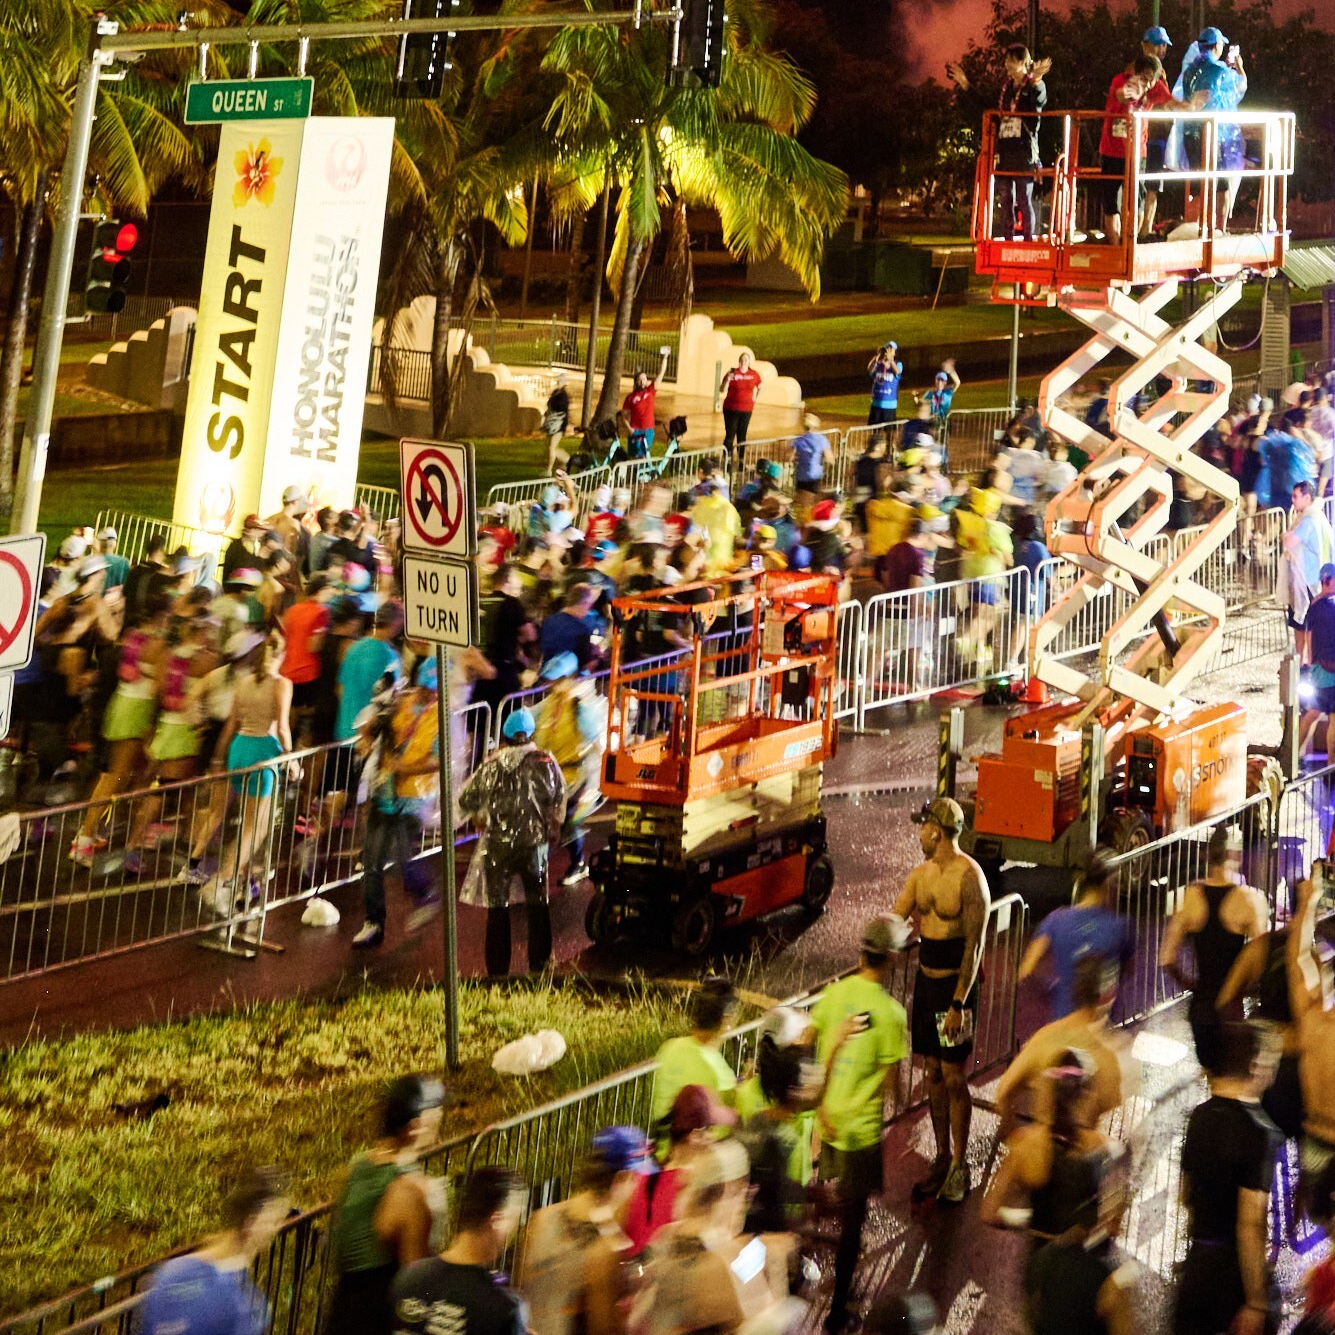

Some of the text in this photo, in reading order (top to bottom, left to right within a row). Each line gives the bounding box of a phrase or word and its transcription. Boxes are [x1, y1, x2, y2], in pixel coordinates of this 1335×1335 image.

[212, 89, 284, 113] QUEEN ST
[206, 223, 267, 460] START
[290, 233, 336, 459] HONOLULU
[316, 234, 361, 463] MARATHON
[416, 604, 459, 634] TURN
[417, 570, 457, 598] NO U
